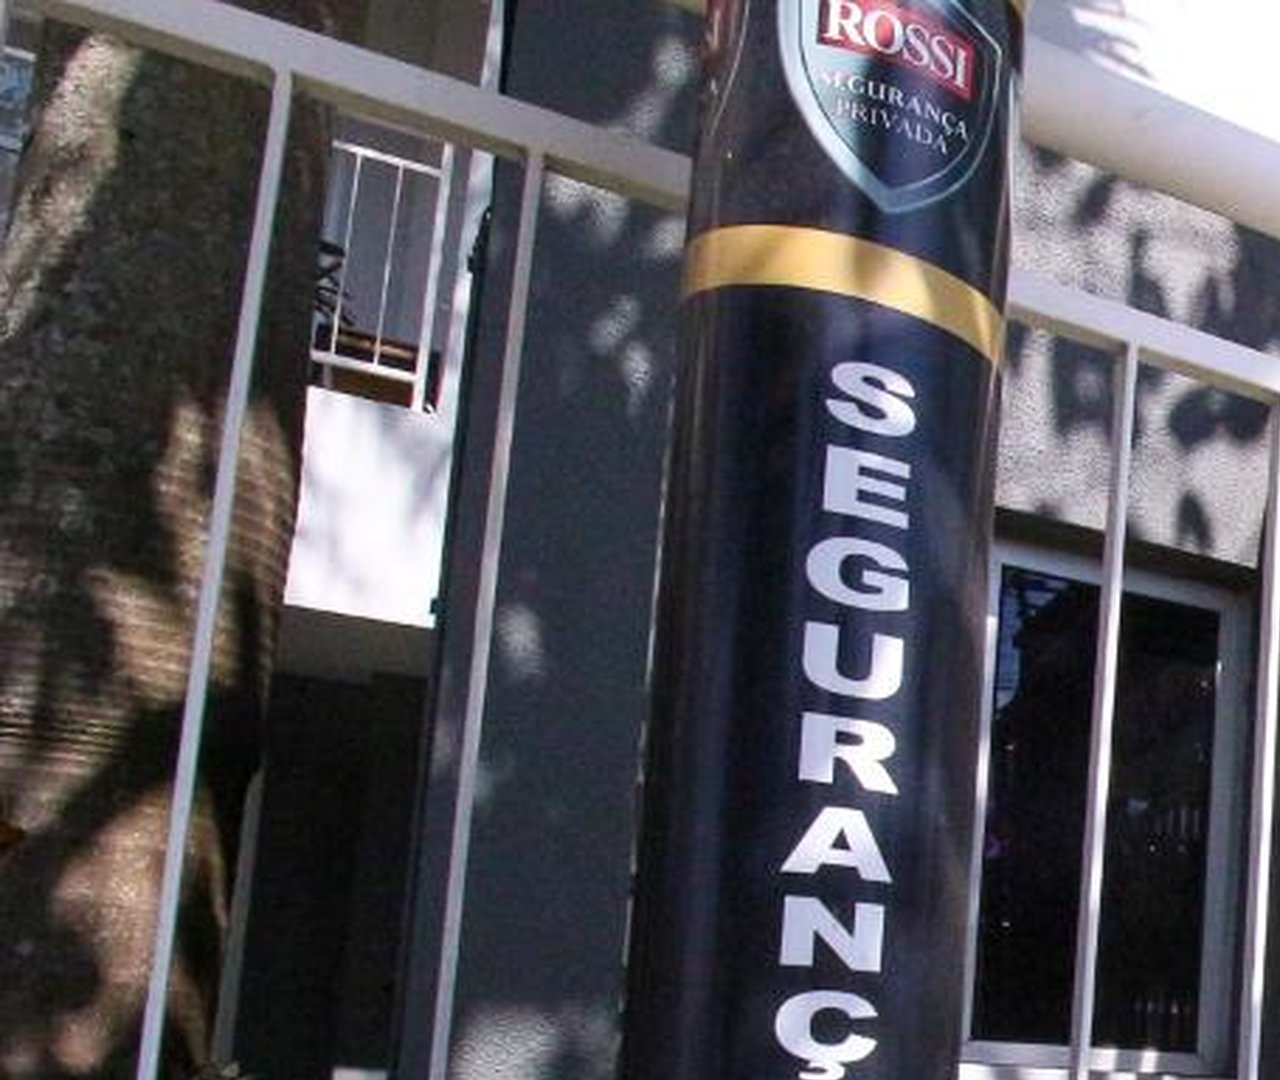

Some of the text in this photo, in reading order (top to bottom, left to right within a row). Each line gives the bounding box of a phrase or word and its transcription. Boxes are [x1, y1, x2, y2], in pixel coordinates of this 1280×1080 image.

[824, 0, 970, 89] ROSSI
[819, 71, 969, 140] SEGURANÇA
[835, 97, 949, 154] PRIVADA
